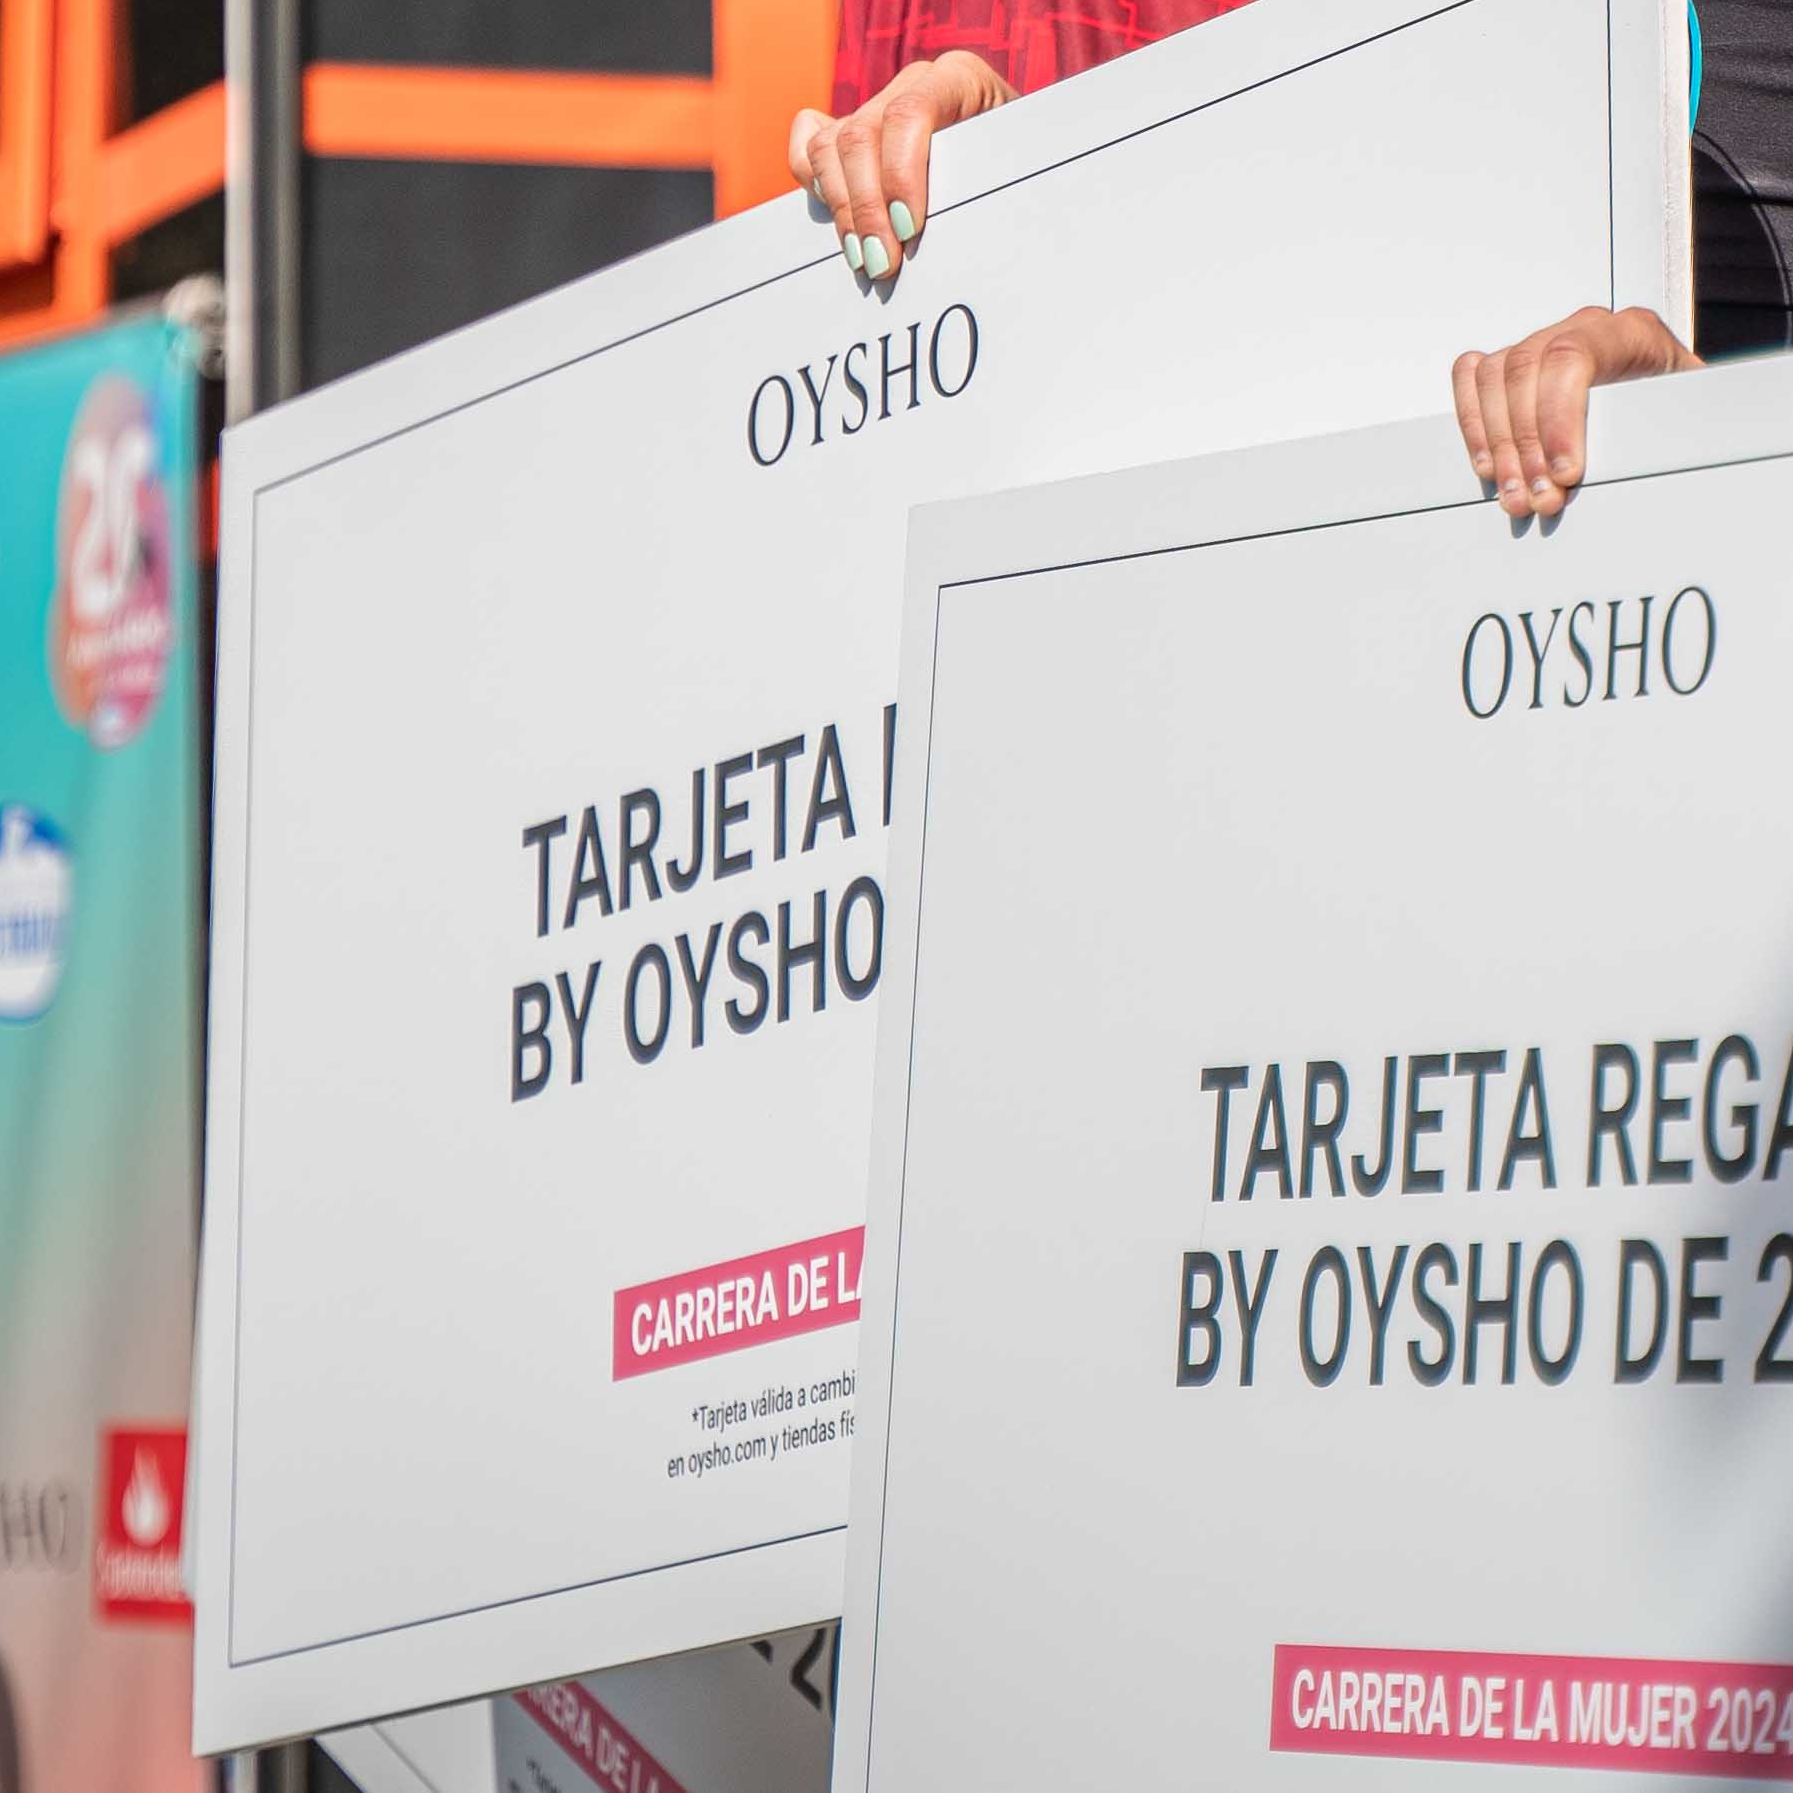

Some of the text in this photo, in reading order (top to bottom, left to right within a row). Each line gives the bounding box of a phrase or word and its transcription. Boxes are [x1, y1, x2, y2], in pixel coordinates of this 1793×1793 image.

[747, 303, 979, 466] OYSHO
[1462, 585, 1717, 719] OYSHO
[522, 722, 857, 939] TARJETA
[511, 875, 885, 1104] BY OYSHO
[1200, 1046, 1558, 1204] TARJETA
[630, 1270, 779, 1357] CARRERA
[787, 1255, 830, 1318] DE
[1176, 1247, 1280, 1389] BY
[1298, 1238, 1586, 1389] OYSHO
[1613, 1235, 1730, 1387] DE
[667, 1455, 685, 1478] en
[688, 1437, 766, 1478] oysho.com
[770, 1434, 779, 1462] y
[781, 1417, 835, 1452] tiendas
[750, 1385, 794, 1418] válida
[797, 1387, 807, 1407] a
[810, 1369, 856, 1404] cambi
[1291, 1668, 1451, 1737] CARRERA
[1459, 1674, 1505, 1740] DE
[1513, 1678, 1559, 1743] LA
[1570, 1681, 1698, 1752] MUJER
